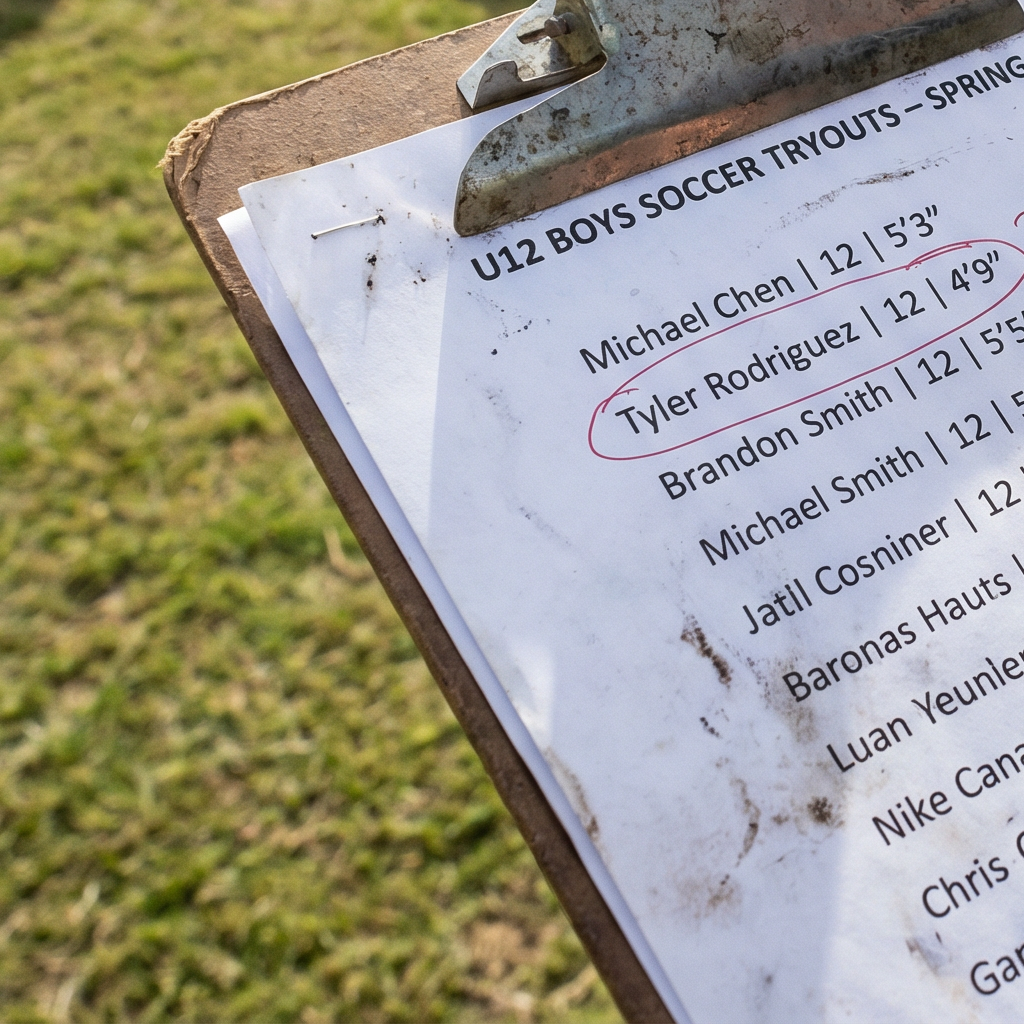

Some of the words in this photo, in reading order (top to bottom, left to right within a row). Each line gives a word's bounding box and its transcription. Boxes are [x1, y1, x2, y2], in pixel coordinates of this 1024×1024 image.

[470, 238, 546, 281] U12
[545, 202, 637, 255] BOYS
[638, 156, 766, 219] SOCCER
[760, 103, 901, 170] TRYOUTS
[579, 301, 710, 374] Michael
[713, 275, 796, 319] Chen
[819, 243, 863, 276] 12
[882, 204, 938, 249] 5'3"
[614, 387, 698, 435] Tyler
[703, 321, 861, 401] Rodriguez
[883, 290, 926, 324] 12
[951, 249, 1000, 292] 4'9"
[658, 427, 799, 501] Brandon
[800, 381, 894, 438] Smith
[917, 350, 960, 385] 12
[698, 485, 830, 567] Michael
[830, 445, 925, 504] Smith
[948, 413, 992, 450] 12
[814, 516, 950, 596] Cosniner
[977, 480, 1022, 517] 12
[781, 622, 917, 703] Baronas
[916, 573, 1012, 633] Hauts
[826, 717, 913, 773] Luan
[871, 791, 953, 846] Nike
[922, 856, 1010, 918] Chris
